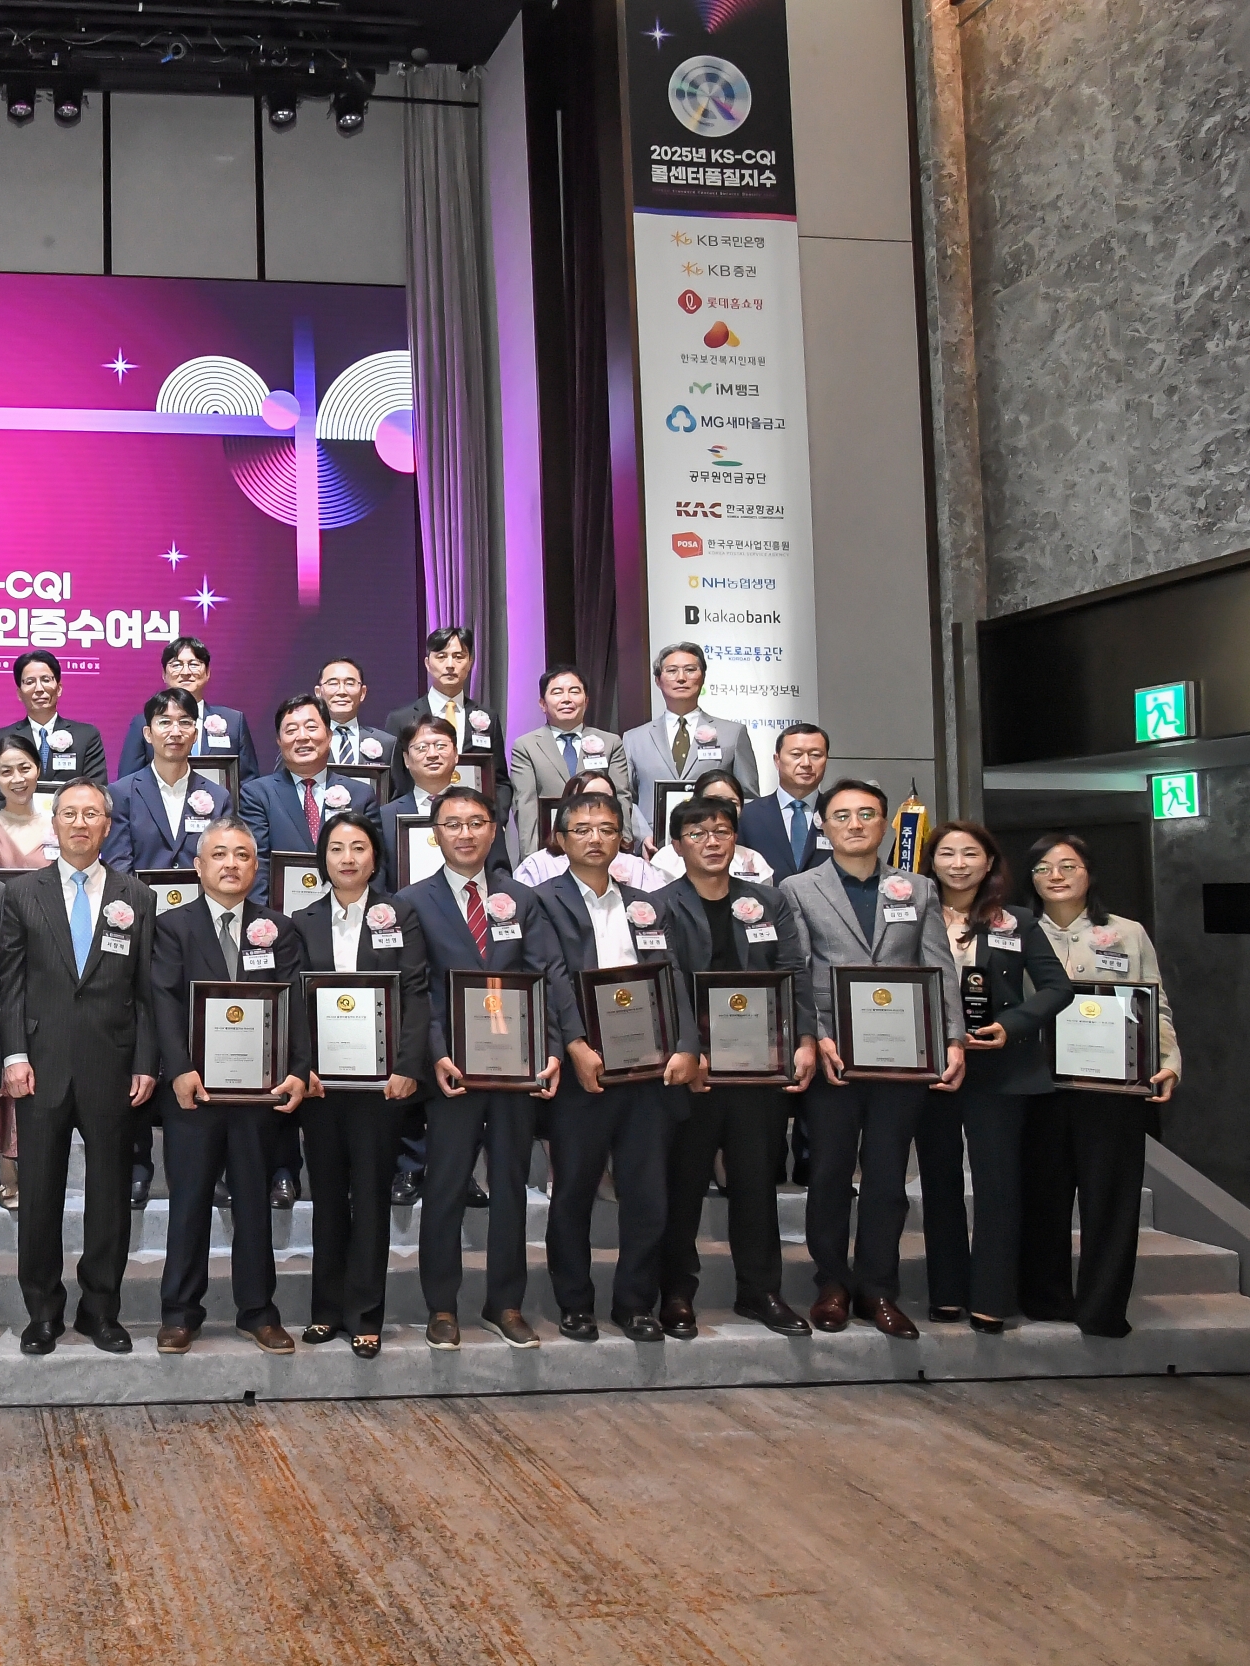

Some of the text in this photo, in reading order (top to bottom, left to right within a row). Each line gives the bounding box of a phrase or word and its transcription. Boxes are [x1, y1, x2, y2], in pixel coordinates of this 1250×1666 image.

[650, 145, 776, 166] 2025년 KS-CQI
[651, 164, 777, 188] 콜센터품질지수
[707, 296, 763, 311] 롯데홈쇼핑
[680, 353, 766, 367] 한국보건복지인재원
[689, 470, 766, 485] 공무원연금공단
[675, 501, 784, 519] KAC 한국공항공사
[677, 540, 698, 548] POSA
[707, 539, 790, 551] 한국우편사업진흥원
[704, 608, 781, 625] kakaobank
[703, 644, 783, 662] 한국도로교통공단
[66, 661, 100, 670] Index
[709, 683, 800, 698] 한국사회보장정보원
[901, 826, 913, 873] 주식회사
